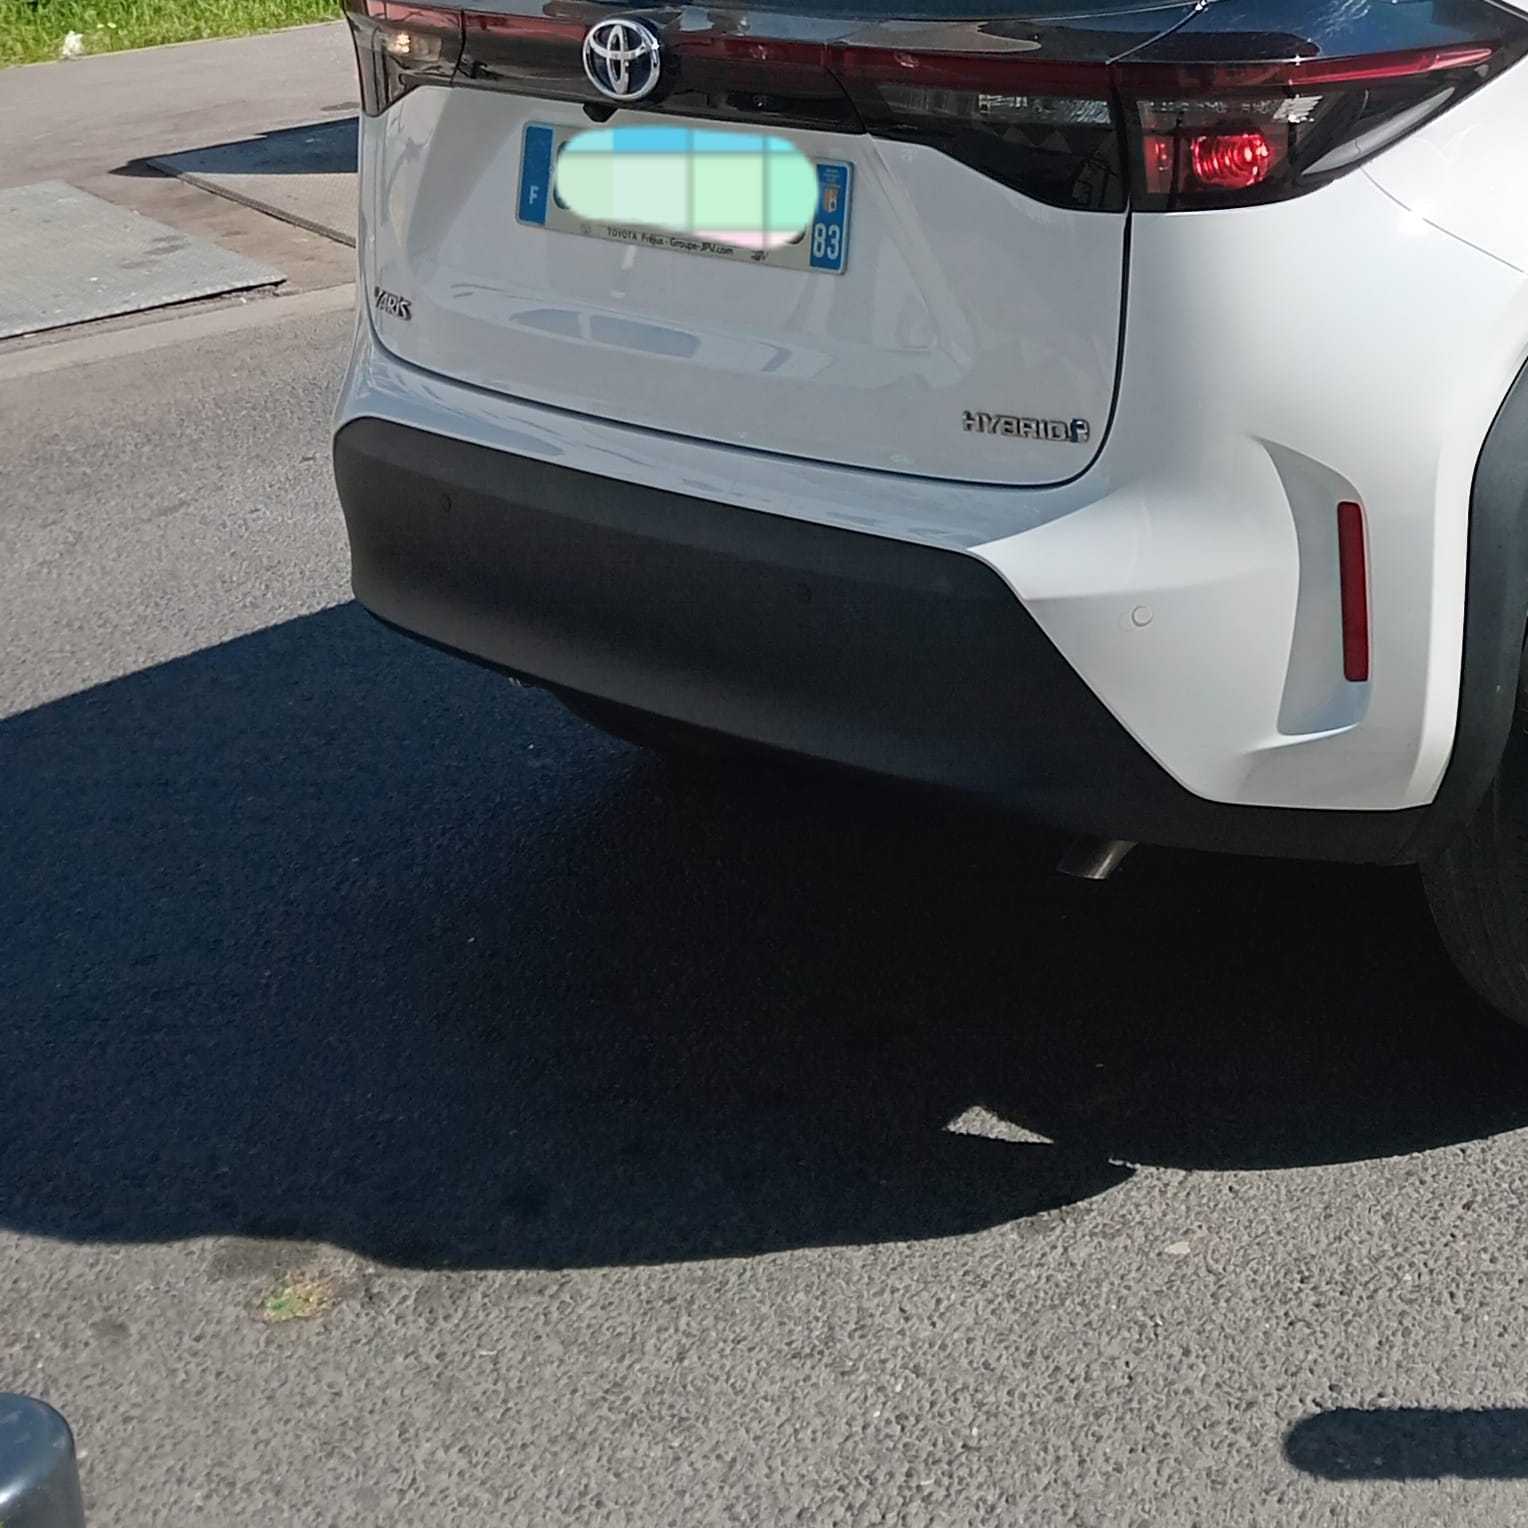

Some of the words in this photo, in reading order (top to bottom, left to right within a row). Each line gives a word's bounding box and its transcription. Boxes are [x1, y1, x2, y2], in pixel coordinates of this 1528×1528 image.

[529, 185, 539, 205] F
[607, 227, 638, 241] TOYOTA
[813, 223, 840, 260] 83
[962, 410, 1070, 442] HYBRID
